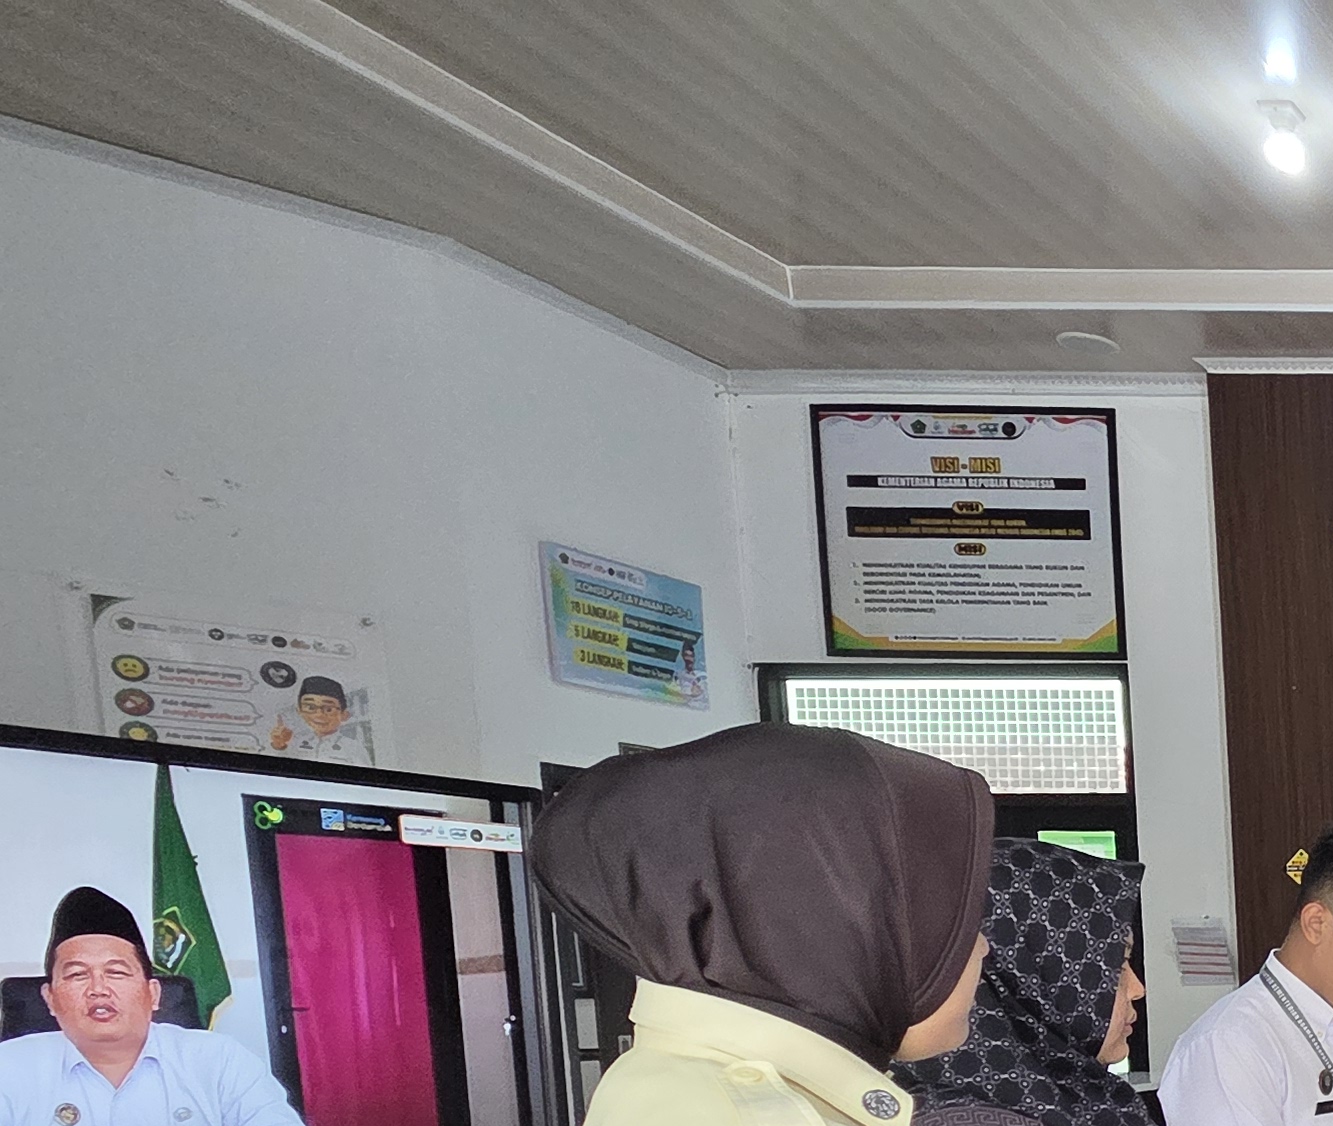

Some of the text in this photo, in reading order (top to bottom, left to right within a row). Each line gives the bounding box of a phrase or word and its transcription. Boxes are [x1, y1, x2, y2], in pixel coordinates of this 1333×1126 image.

[931, 457, 960, 473] VISI
[968, 457, 1001, 473] MISI
[877, 476, 1056, 490] KEMENTERIAN AGAMA REPUBLIK INDONESIA
[574, 624, 580, 638] 5
